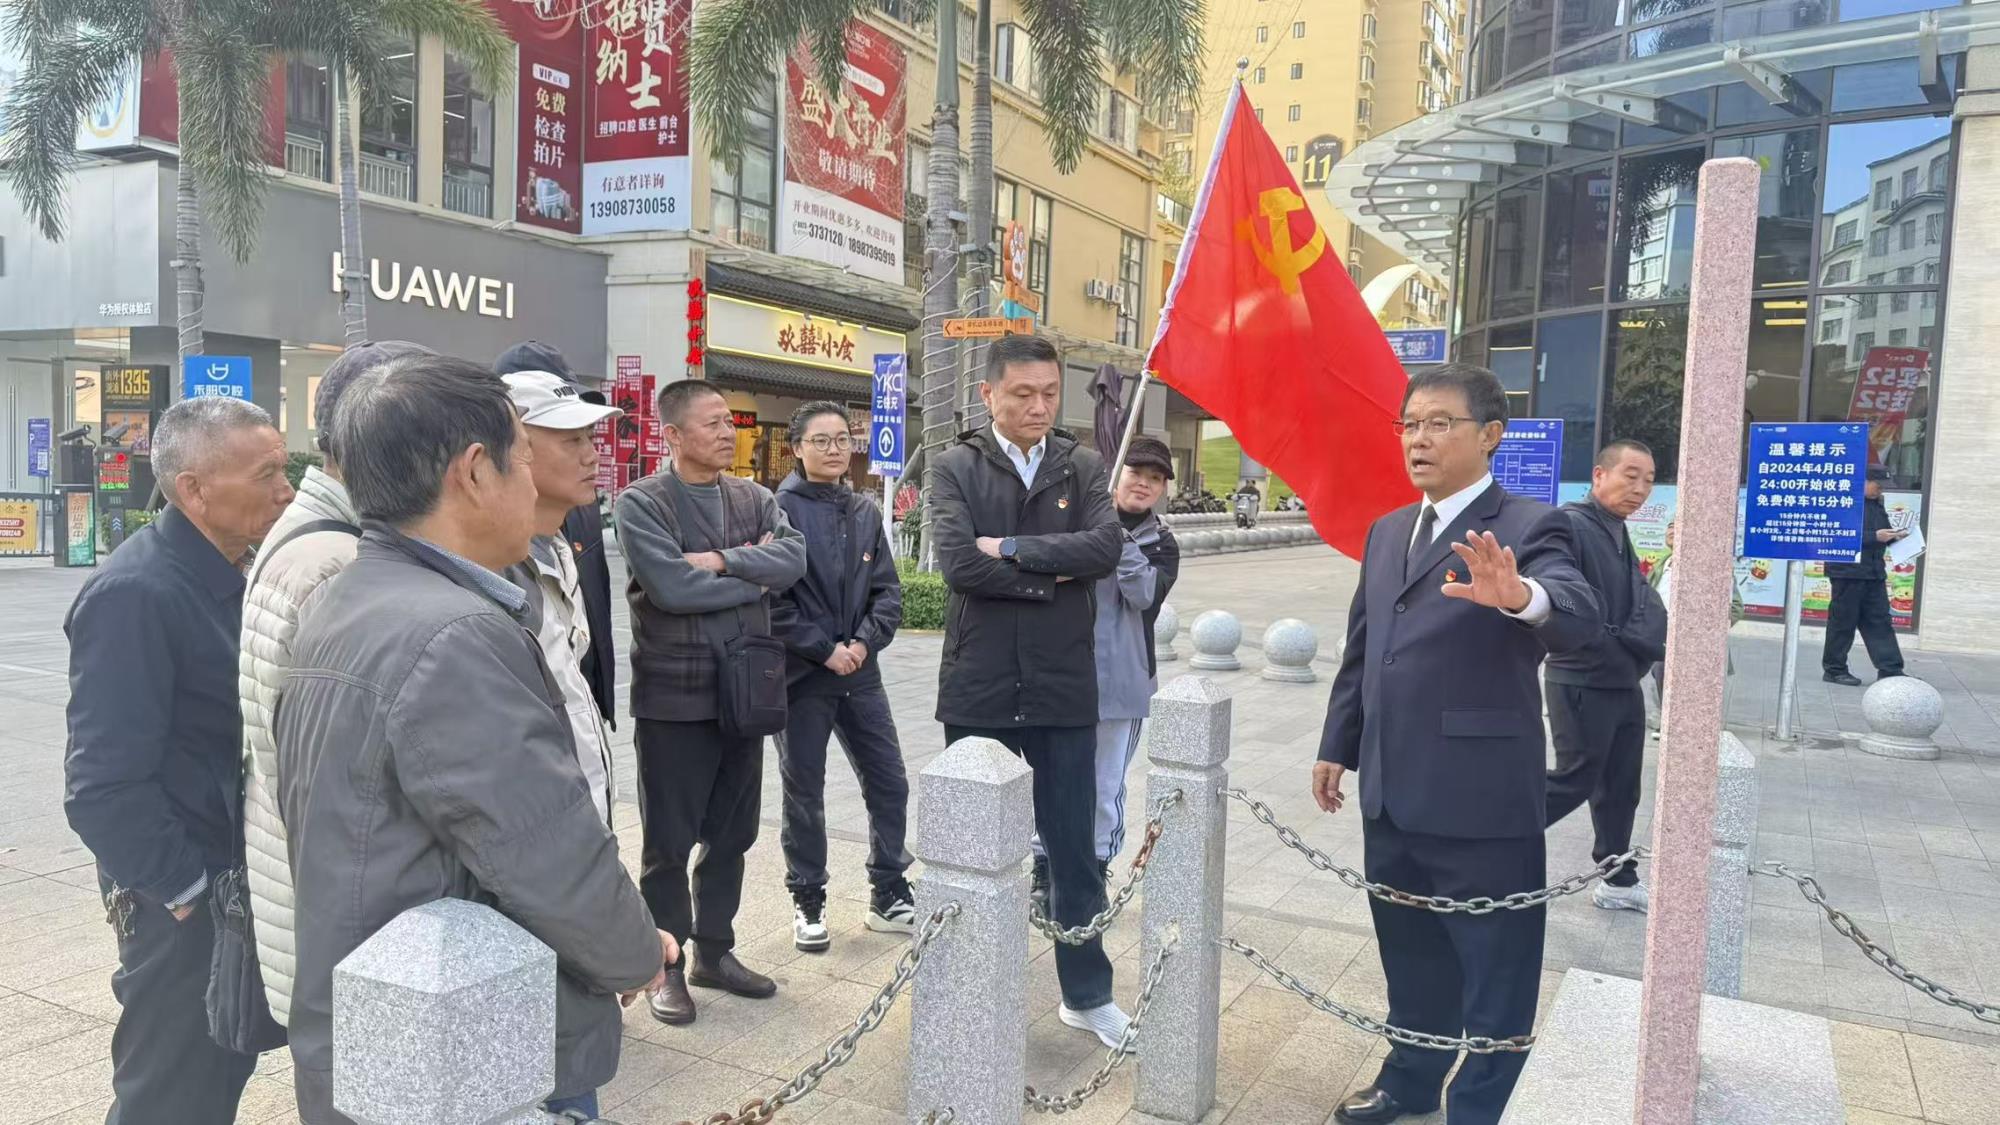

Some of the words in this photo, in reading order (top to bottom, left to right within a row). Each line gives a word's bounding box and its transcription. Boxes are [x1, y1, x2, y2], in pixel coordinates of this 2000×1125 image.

[539, 67, 553, 81] VIP
[535, 87, 566, 116] 免费
[534, 114, 566, 143] 检查
[658, 131, 677, 145] 护士
[534, 140, 566, 169] 拍片
[819, 147, 877, 192] 敬请期待
[1304, 153, 1331, 183] 11
[602, 173, 665, 193] 有意者详询
[590, 196, 675, 218] 13908730058
[120, 369, 150, 395] 1395
[874, 373, 903, 393] YKC
[1768, 443, 1846, 457] 温馨提示
[1758, 462, 1855, 475] 自2024年4月6日
[1760, 479, 1851, 491] 24:00开始收费
[1756, 494, 1854, 508] 免费停车15分钟
